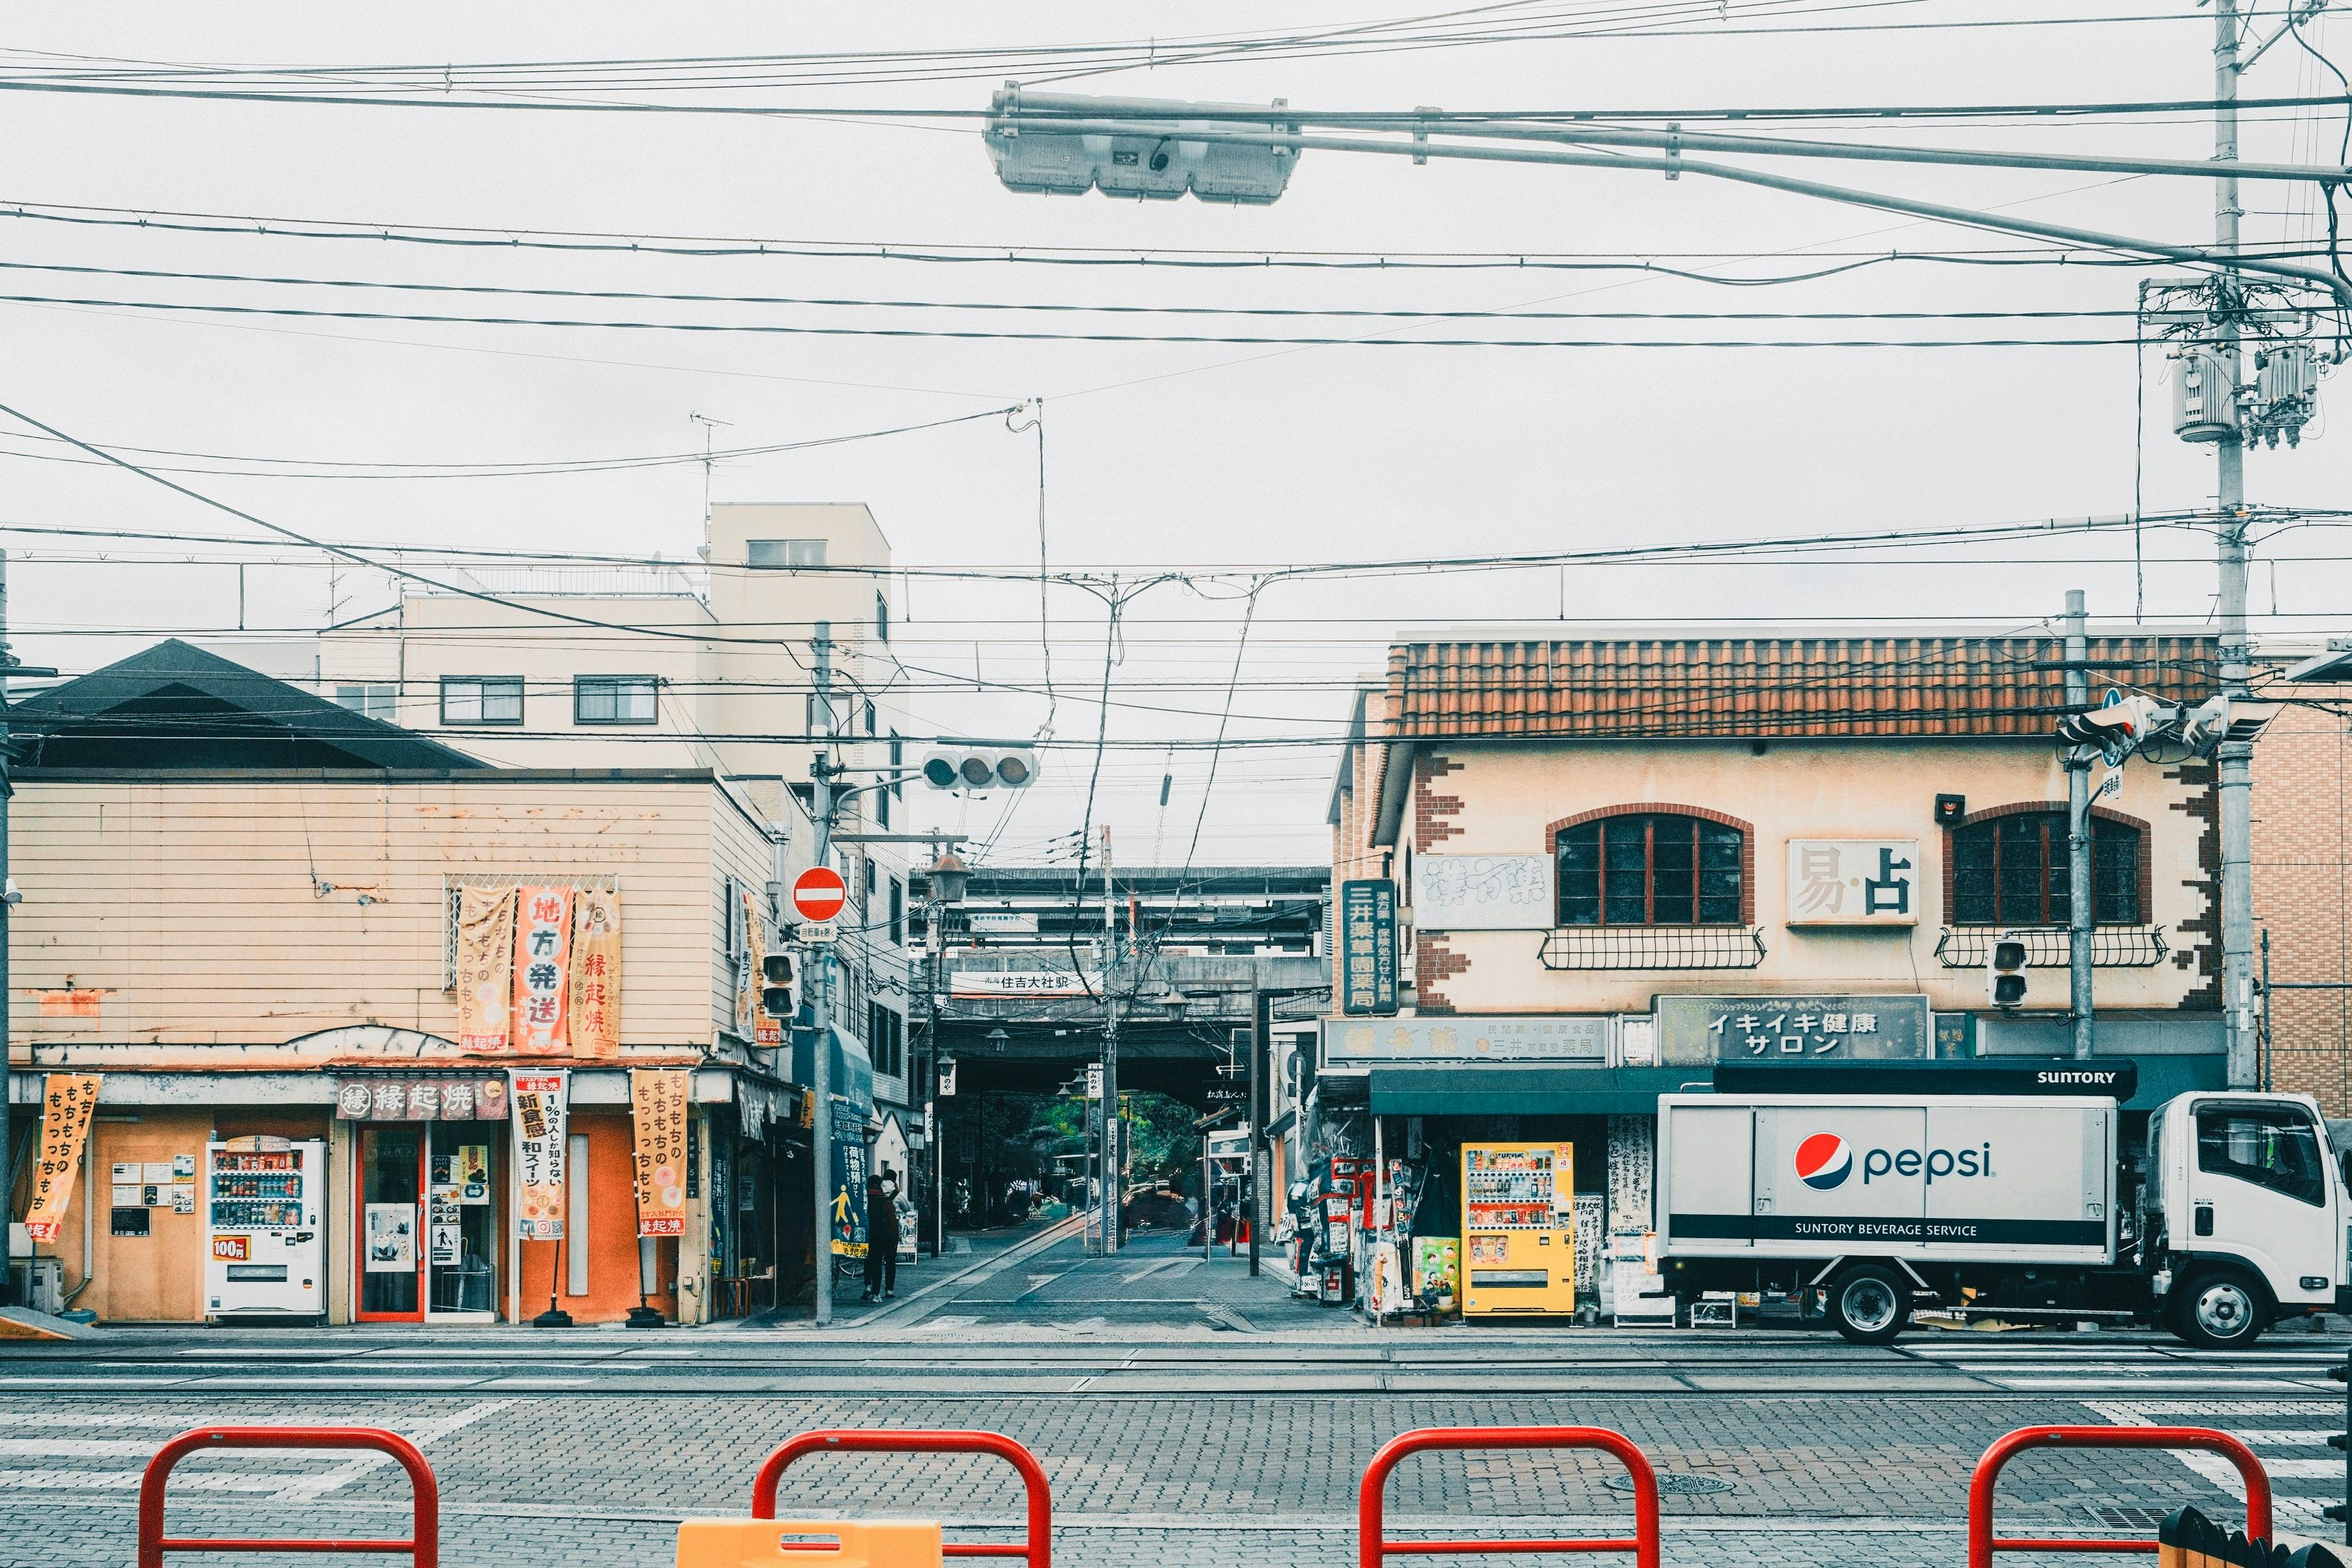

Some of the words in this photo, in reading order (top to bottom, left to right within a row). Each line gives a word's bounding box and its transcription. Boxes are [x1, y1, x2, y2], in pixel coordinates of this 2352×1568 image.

[1797, 847, 1911, 915] 易・占
[802, 928, 834, 937] 自転車を除く
[1349, 888, 1375, 1007] 三井薬草園薬局
[1377, 892, 1392, 1002] 漢方薬・保険処方せん調剤
[529, 897, 560, 1023] 地方発送
[1001, 976, 1068, 989] 住吉大社駅
[585, 954, 607, 1033] 縁起焼
[1709, 1013, 1877, 1034] イキイキ健康
[1744, 1035, 1838, 1054] サロン
[375, 1084, 472, 1111] 縁起焼
[2037, 1071, 2117, 1084] SUNTORY
[57, 1086, 77, 1172] もちもちの
[517, 1094, 547, 1139] 新食感
[654, 1080, 667, 1165] もちもちの
[669, 1073, 683, 1159] もちもちの
[545, 1094, 562, 1186] 1%の人しか知らない
[522, 1141, 542, 1187] 和スイーツ
[849, 1146, 860, 1198] 荷物預けて
[1864, 1142, 1991, 1185] pepsi
[640, 1219, 682, 1234] 縁起焼
[1795, 1223, 1855, 1234] SUNTORY
[1859, 1223, 1922, 1235] BEVERAGE
[1926, 1225, 1977, 1236] SERVICE
